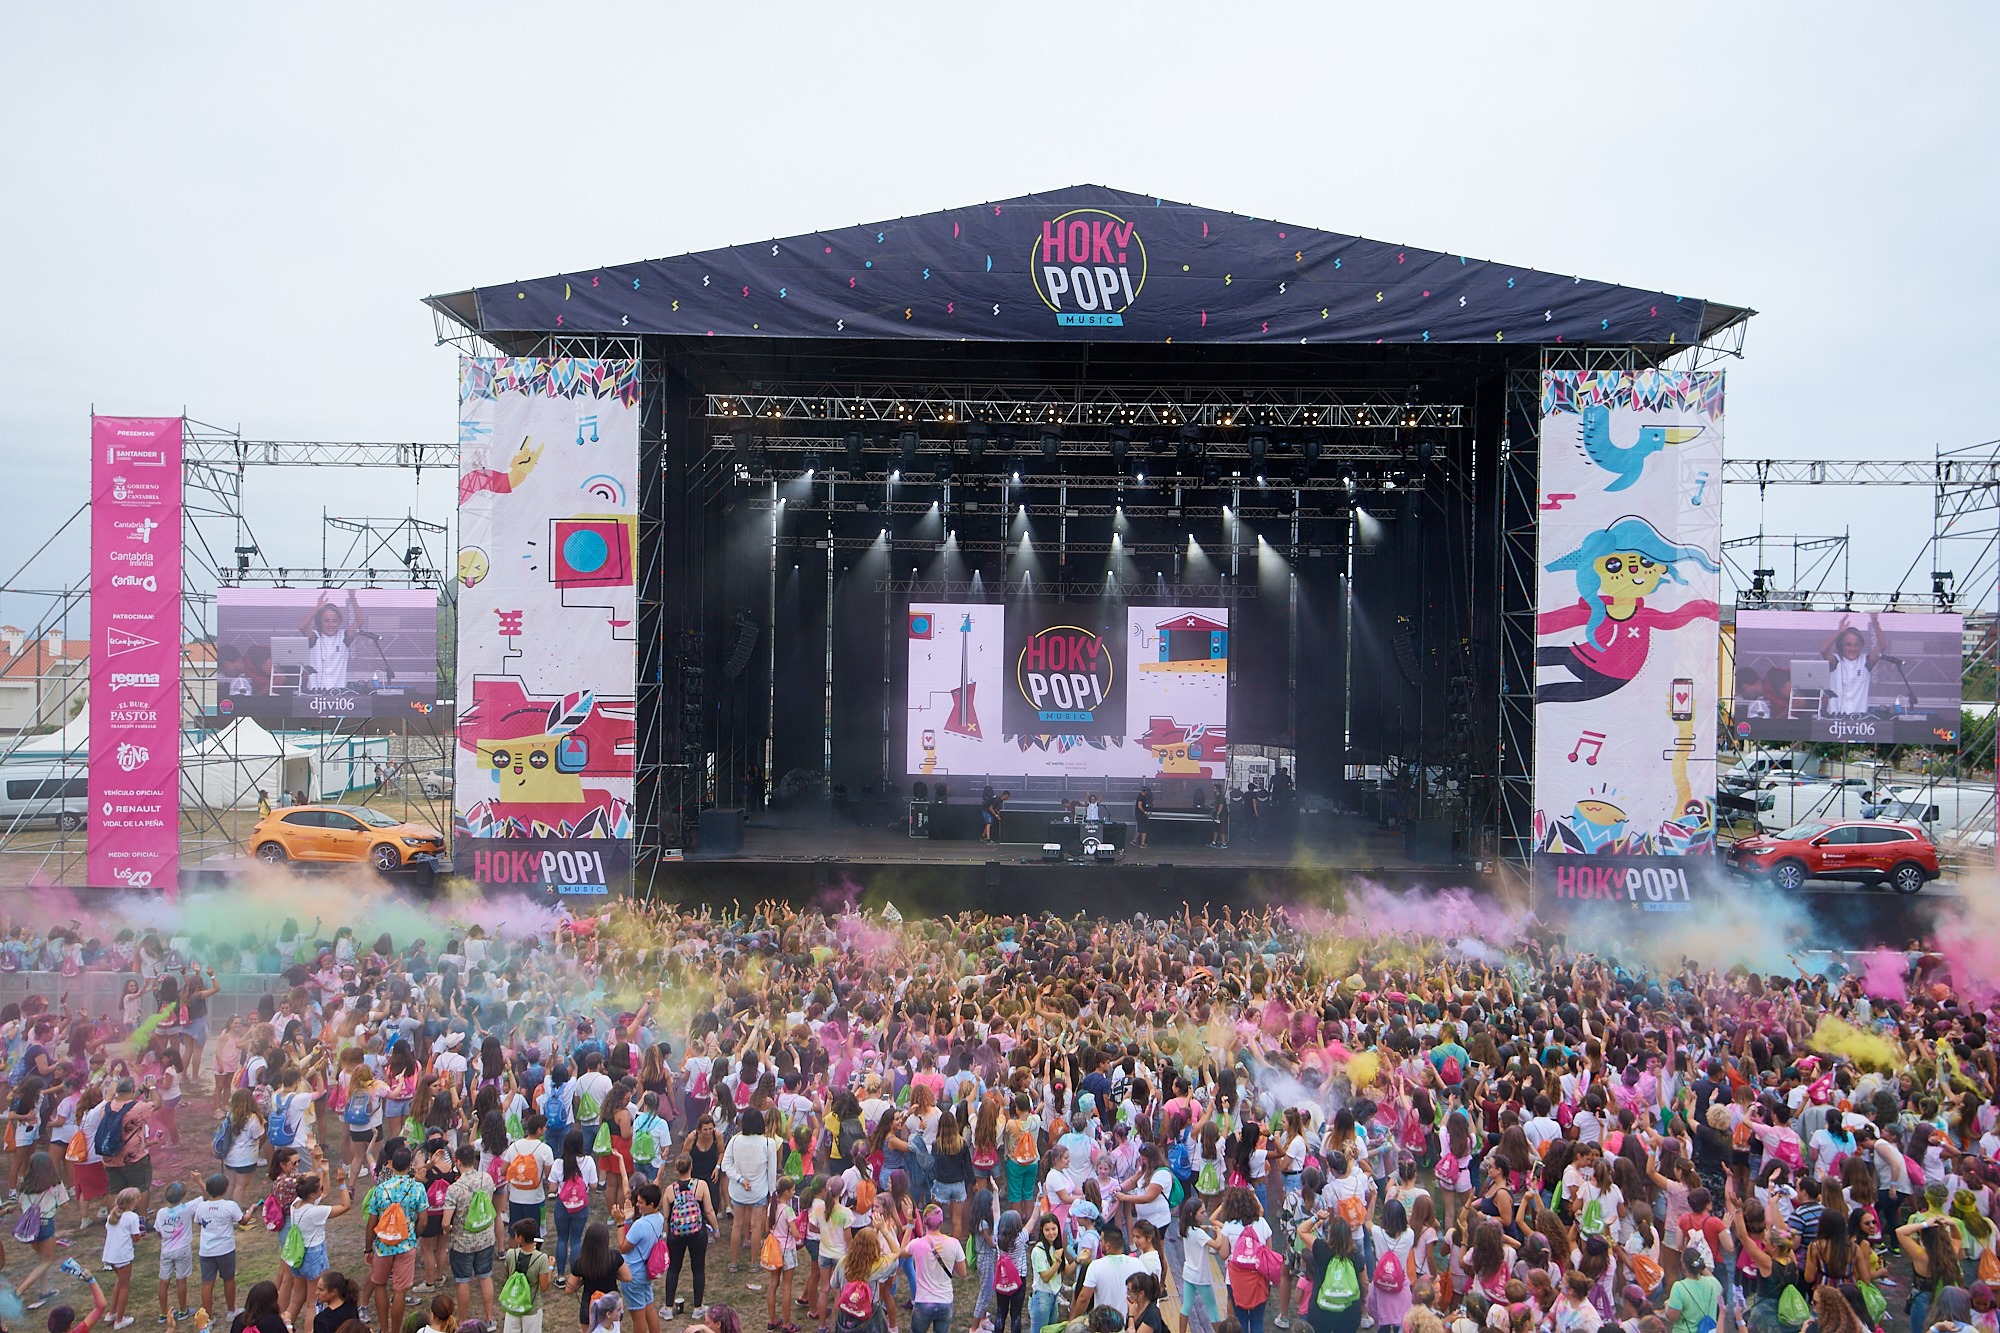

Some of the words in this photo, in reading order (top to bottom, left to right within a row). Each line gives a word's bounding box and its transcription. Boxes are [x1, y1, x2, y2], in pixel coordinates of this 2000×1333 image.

[1043, 266, 1134, 311] POPI
[1066, 316, 1114, 324] MUSIC
[110, 551, 153, 560] Cantabria
[112, 673, 159, 686] regma
[1028, 673, 1102, 709] POPI
[309, 698, 355, 715] djivi06
[110, 711, 157, 720] PASTOR
[1828, 722, 1875, 738] djivi06
